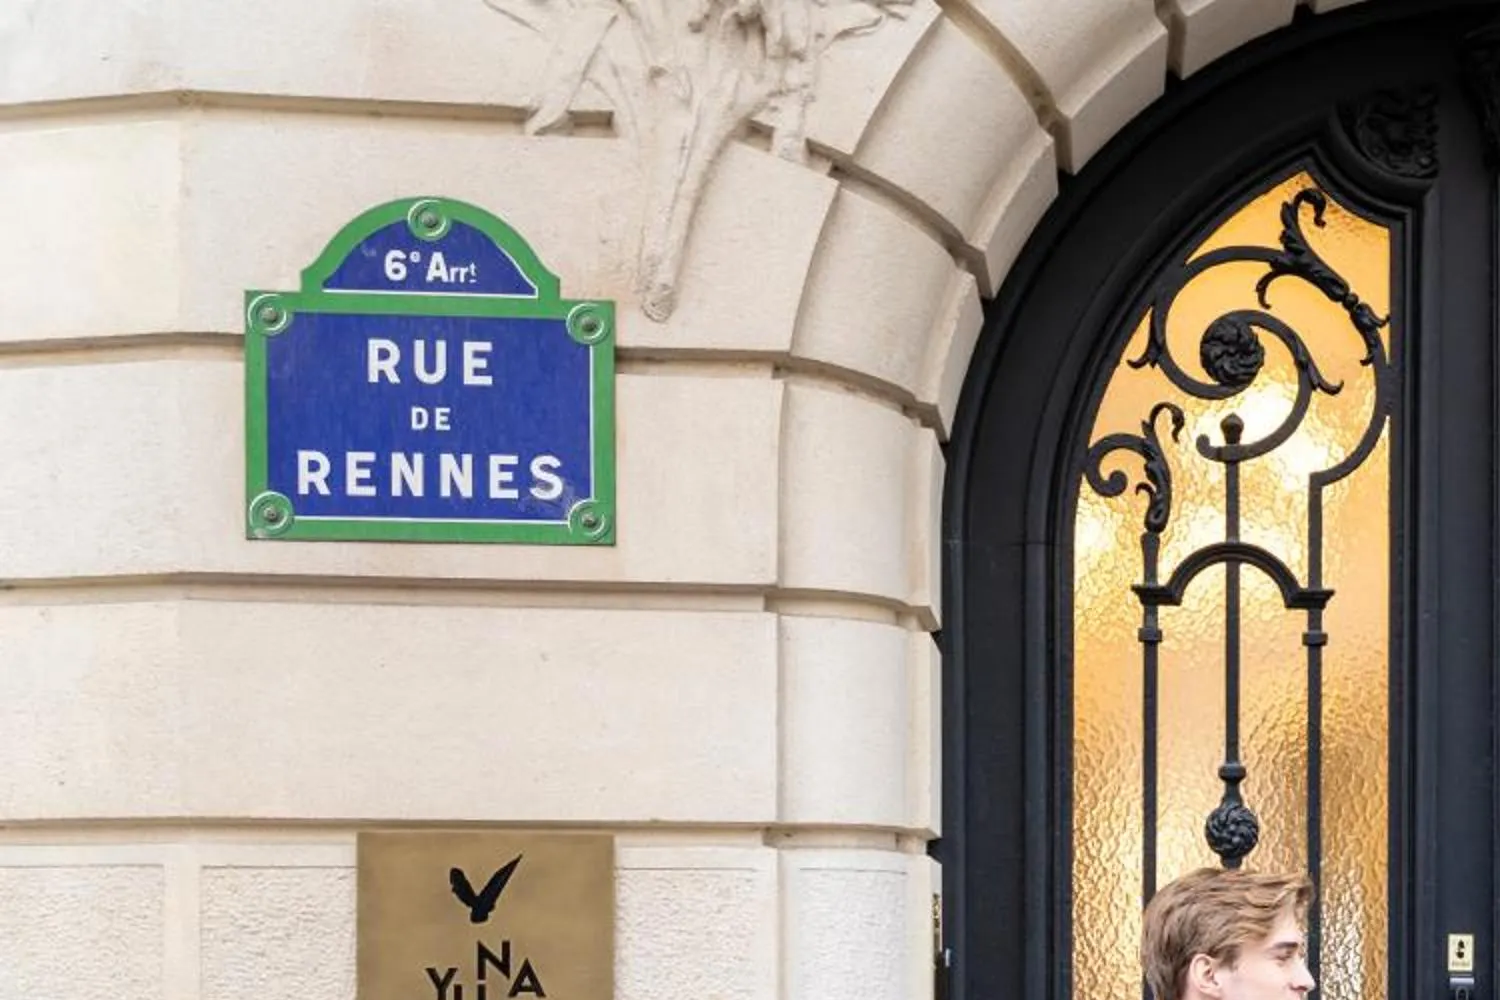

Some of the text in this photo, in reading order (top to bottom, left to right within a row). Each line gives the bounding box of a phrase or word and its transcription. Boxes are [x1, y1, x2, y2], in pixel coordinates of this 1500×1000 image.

[367, 338, 493, 385] RUE
[411, 407, 451, 431] DE
[297, 449, 563, 501] RENNES
